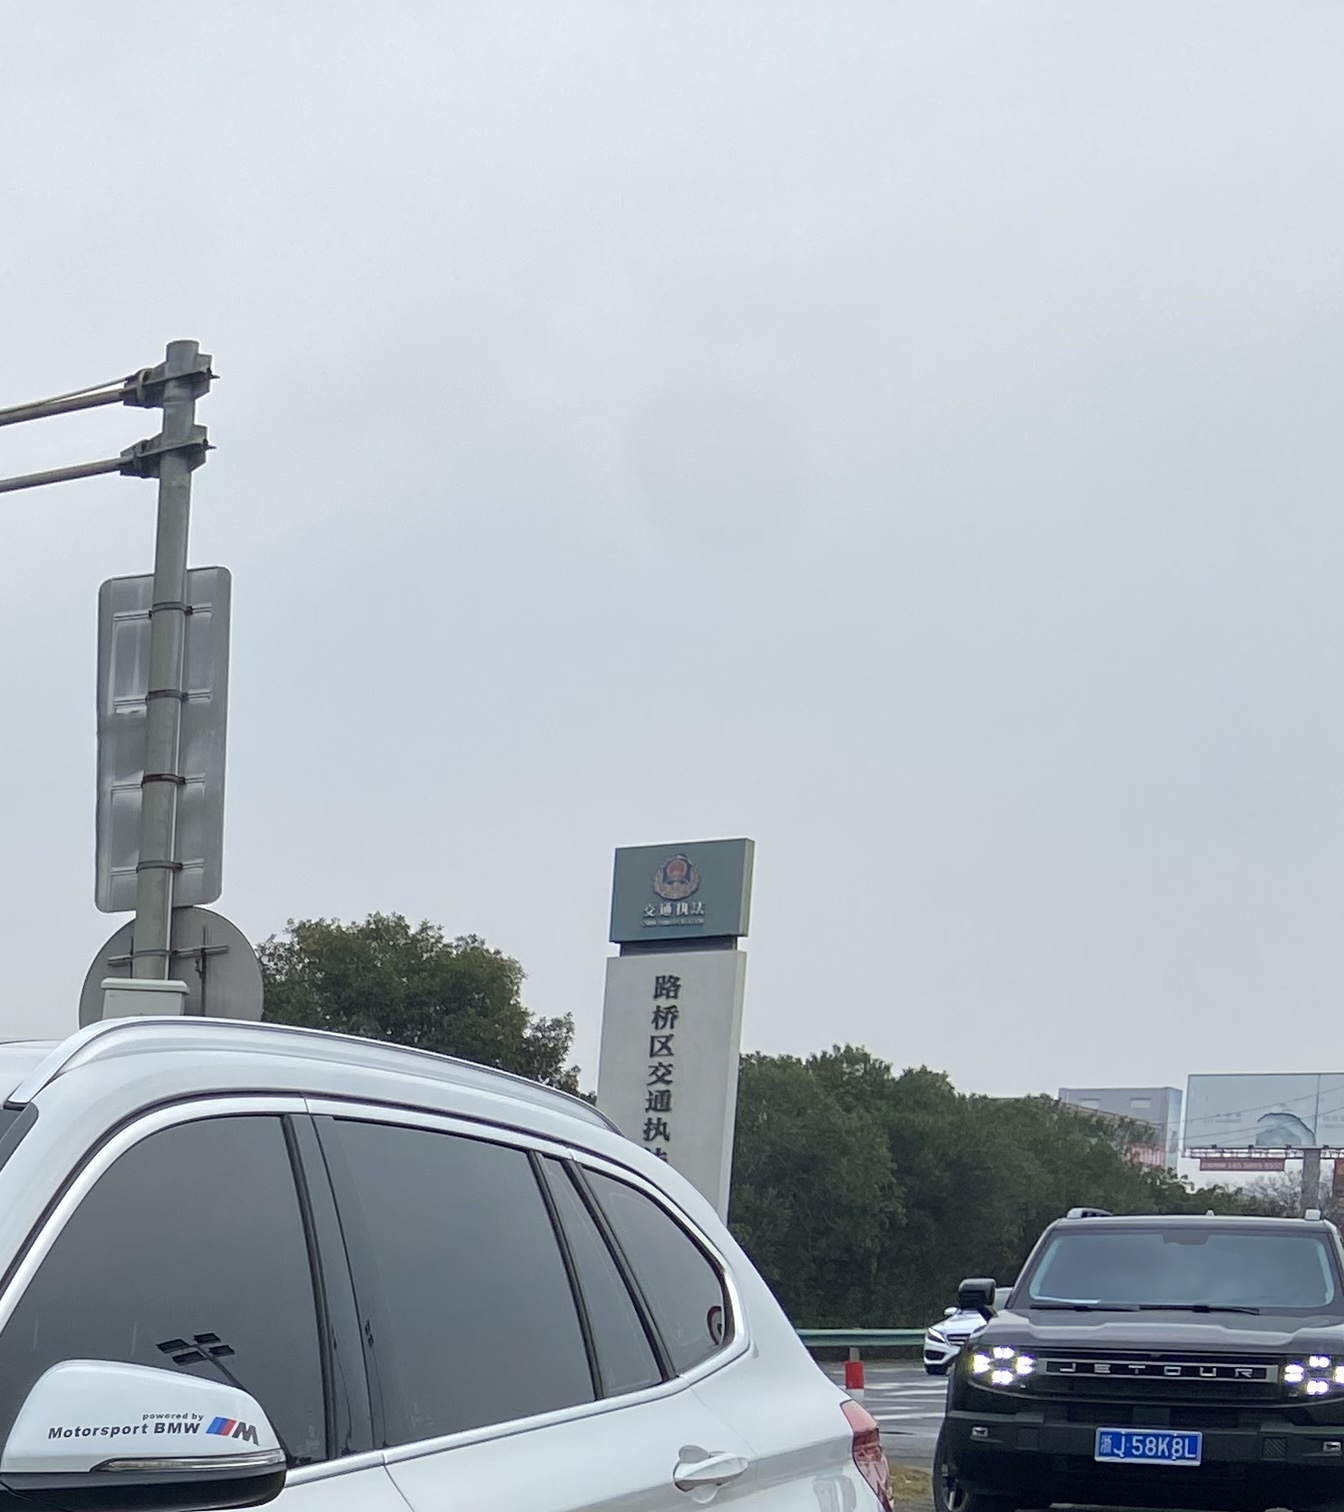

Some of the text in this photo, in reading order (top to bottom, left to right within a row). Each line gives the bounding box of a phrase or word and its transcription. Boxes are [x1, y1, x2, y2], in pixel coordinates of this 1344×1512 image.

[1059, 1362, 1254, 1379] JETOUR
[142, 1412, 204, 1422] powered by
[47, 1422, 149, 1440] Motorsport
[153, 1421, 201, 1435] BMW
